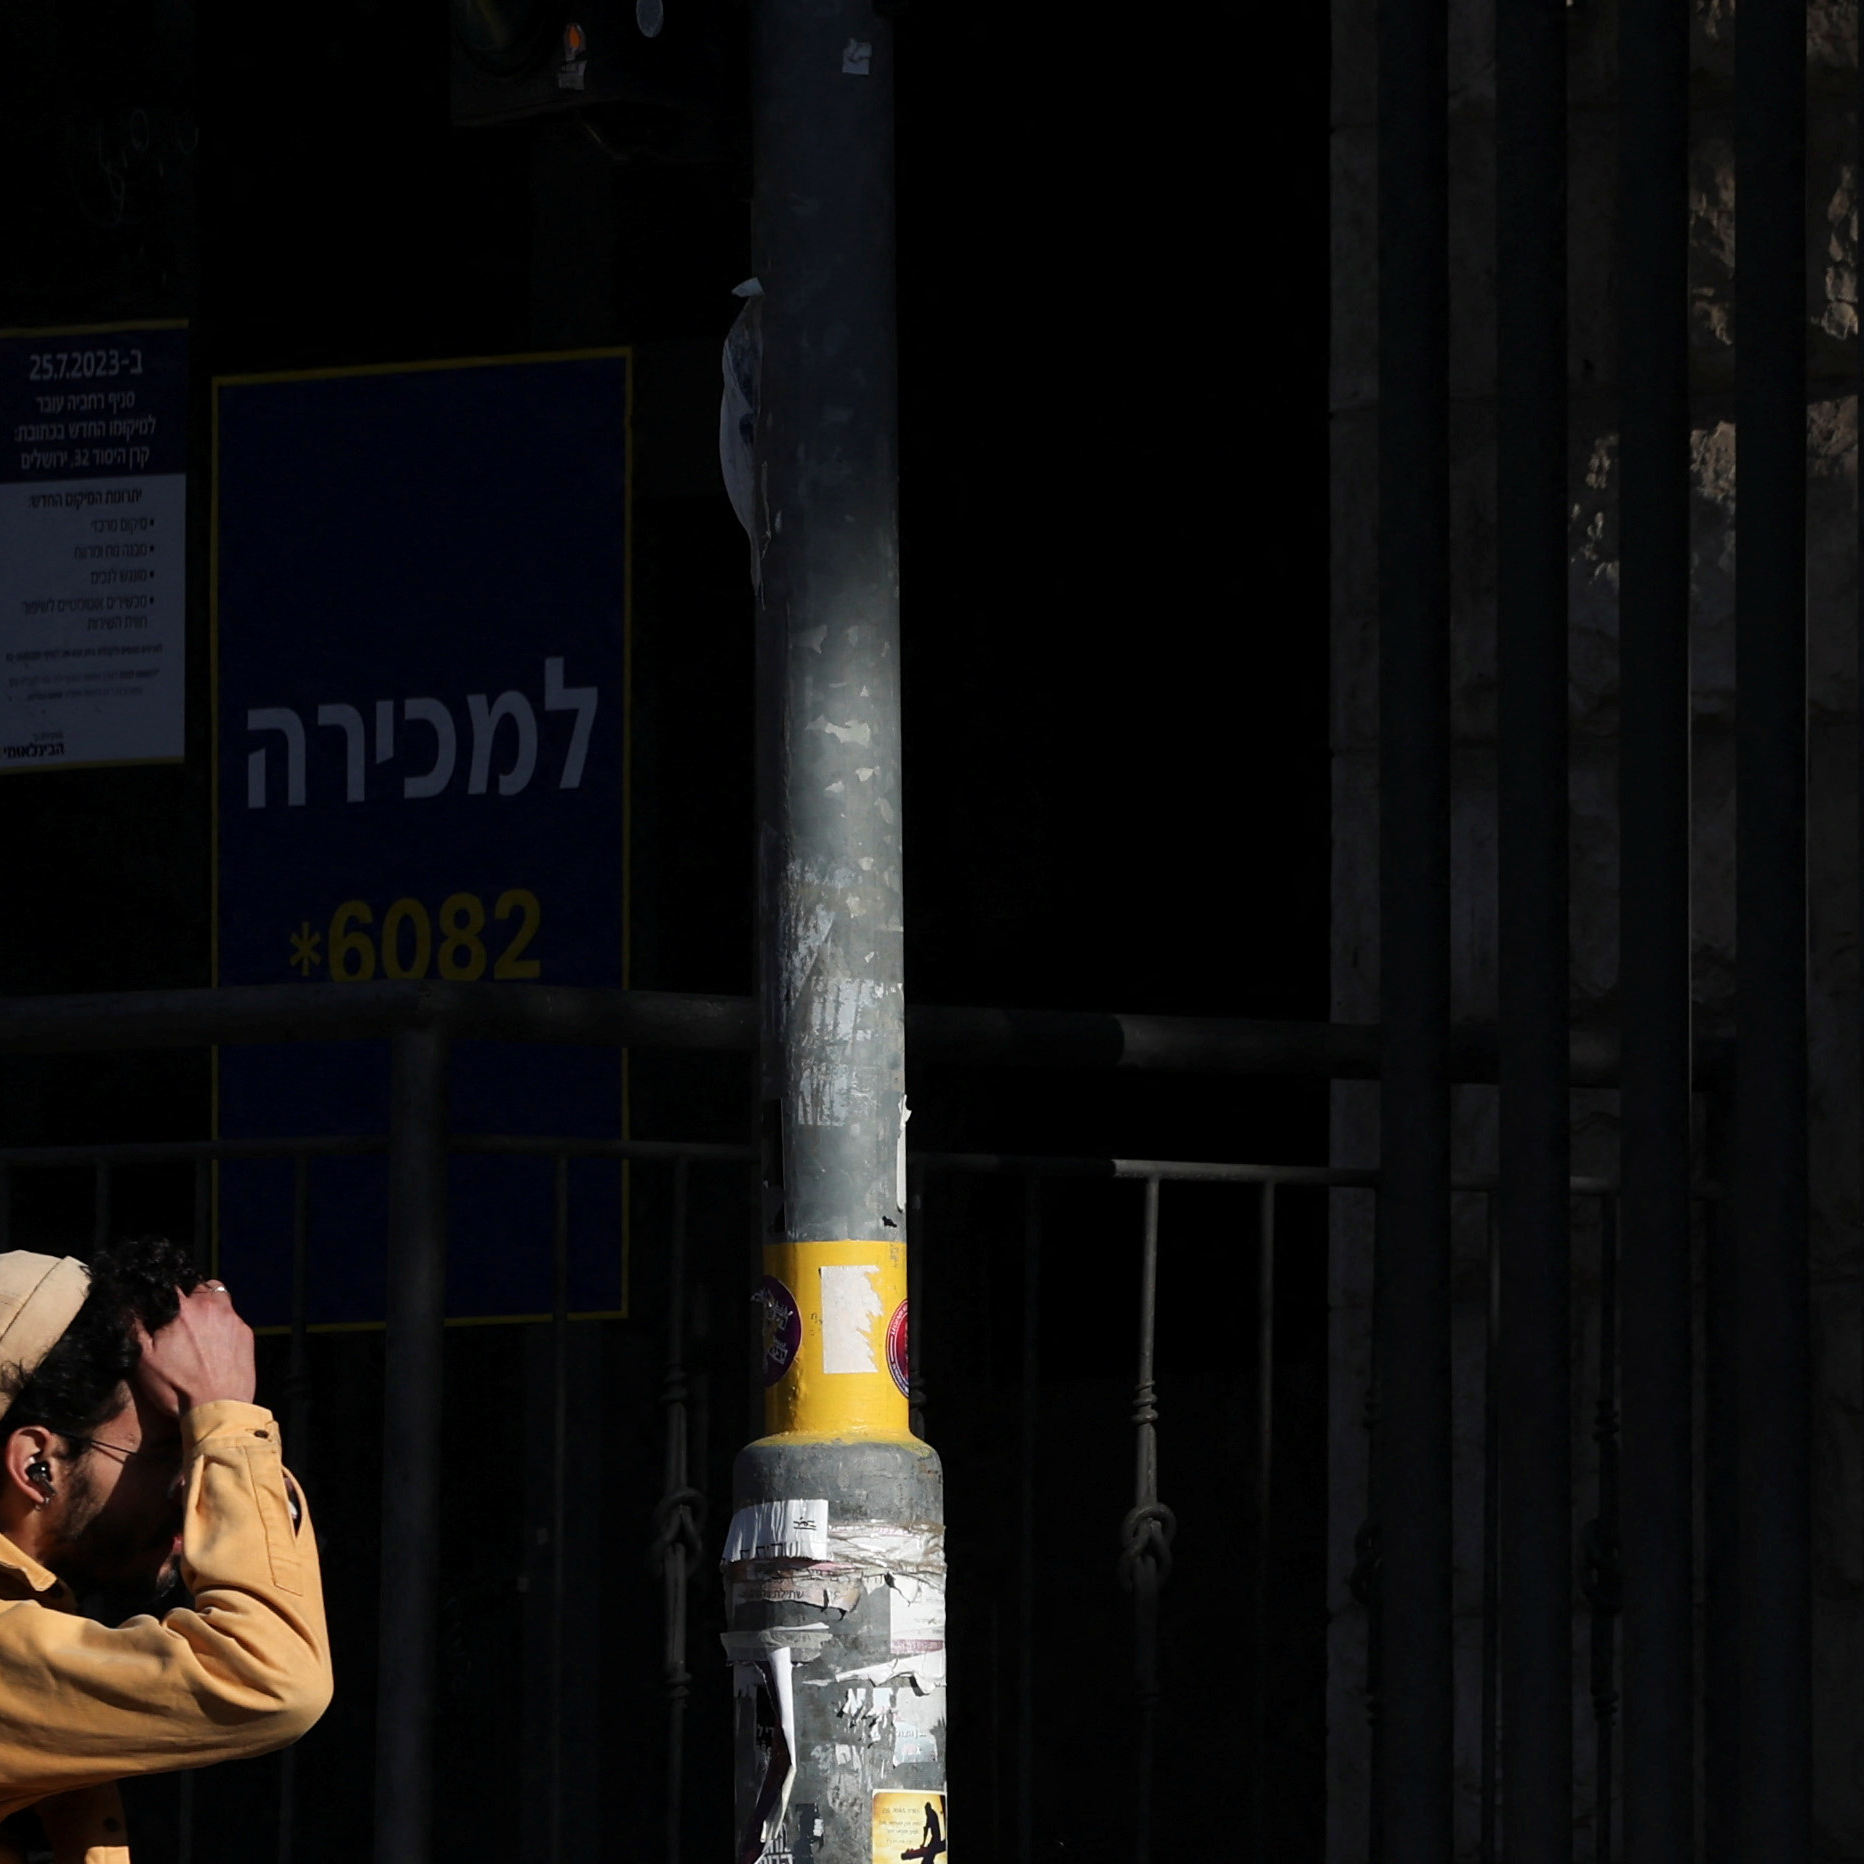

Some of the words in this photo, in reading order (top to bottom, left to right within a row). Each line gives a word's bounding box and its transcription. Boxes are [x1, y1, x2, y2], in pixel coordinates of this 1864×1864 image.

[29, 349, 143, 381] ב-25.7.2023
[36, 395, 64, 415] עובר
[68, 393, 104, 411] רחביה
[108, 391, 135, 414] סניף
[68, 420, 106, 440] החדש
[21, 449, 68, 469] ירושלים
[93, 448, 126, 465] היסוד
[129, 447, 150, 469] קרן
[65, 492, 102, 510] המיקום
[244, 654, 599, 811] למכירה
[3, 742, 64, 760] הבינלאומי
